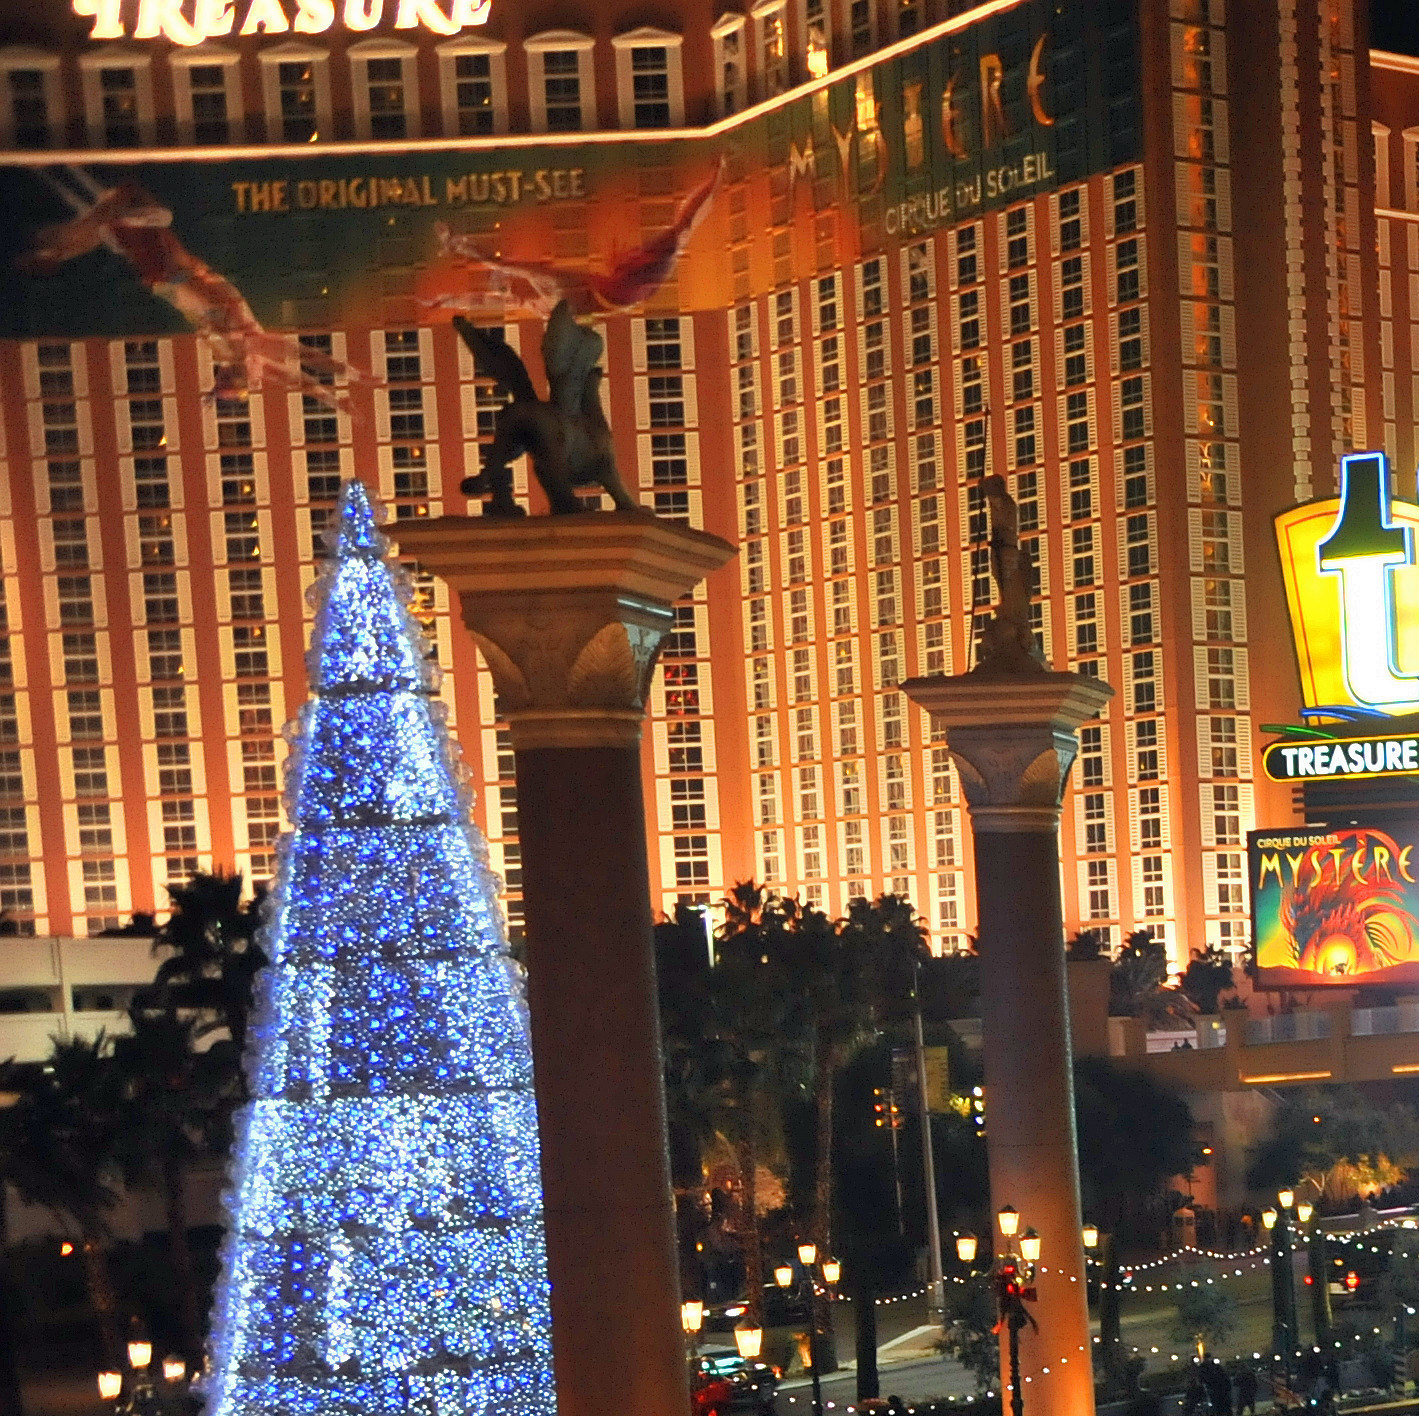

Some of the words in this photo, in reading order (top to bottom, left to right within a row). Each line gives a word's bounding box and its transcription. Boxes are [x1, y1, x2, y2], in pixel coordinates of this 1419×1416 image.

[232, 180, 289, 212] THE
[298, 176, 438, 208] ORIGINAL
[447, 169, 584, 204] MUST-SEE
[885, 187, 950, 234] CIRQUE
[956, 175, 981, 207] DU
[987, 152, 1054, 198] SOLEIL
[1281, 739, 1417, 776] TREASURE
[1257, 837, 1291, 850] CIRQUE
[1293, 836, 1308, 847] DU
[1308, 834, 1341, 846] SOLEIL
[1258, 840, 1415, 889] MYSTÈRE
